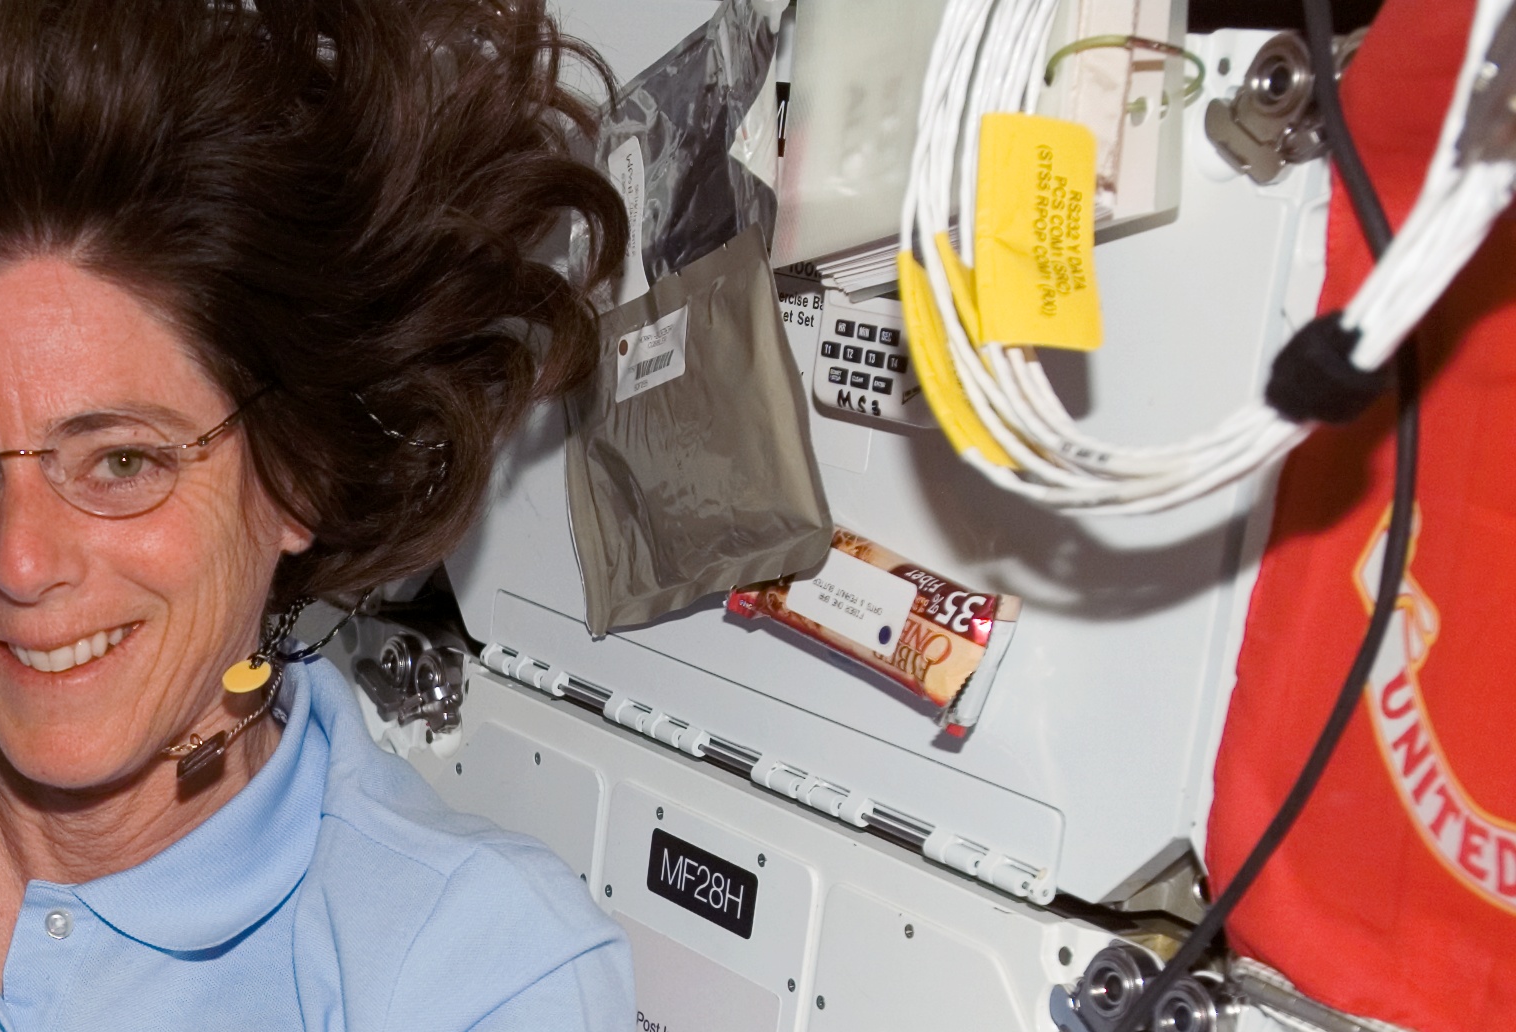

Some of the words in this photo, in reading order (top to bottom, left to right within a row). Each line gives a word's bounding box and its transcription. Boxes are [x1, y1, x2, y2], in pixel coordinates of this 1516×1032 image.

[1051, 175, 1068, 211] PCS
[1066, 189, 1083, 240] RS232
[1068, 256, 1086, 290] DATA
[779, 292, 809, 307] ercise
[782, 310, 793, 323] et
[797, 311, 815, 328] Set
[846, 347, 854, 359] T2
[904, 568, 947, 597] Fiber
[844, 604, 865, 620] FIBER
[1381, 668, 1516, 897] UNITED
[660, 847, 745, 920] MF28H
